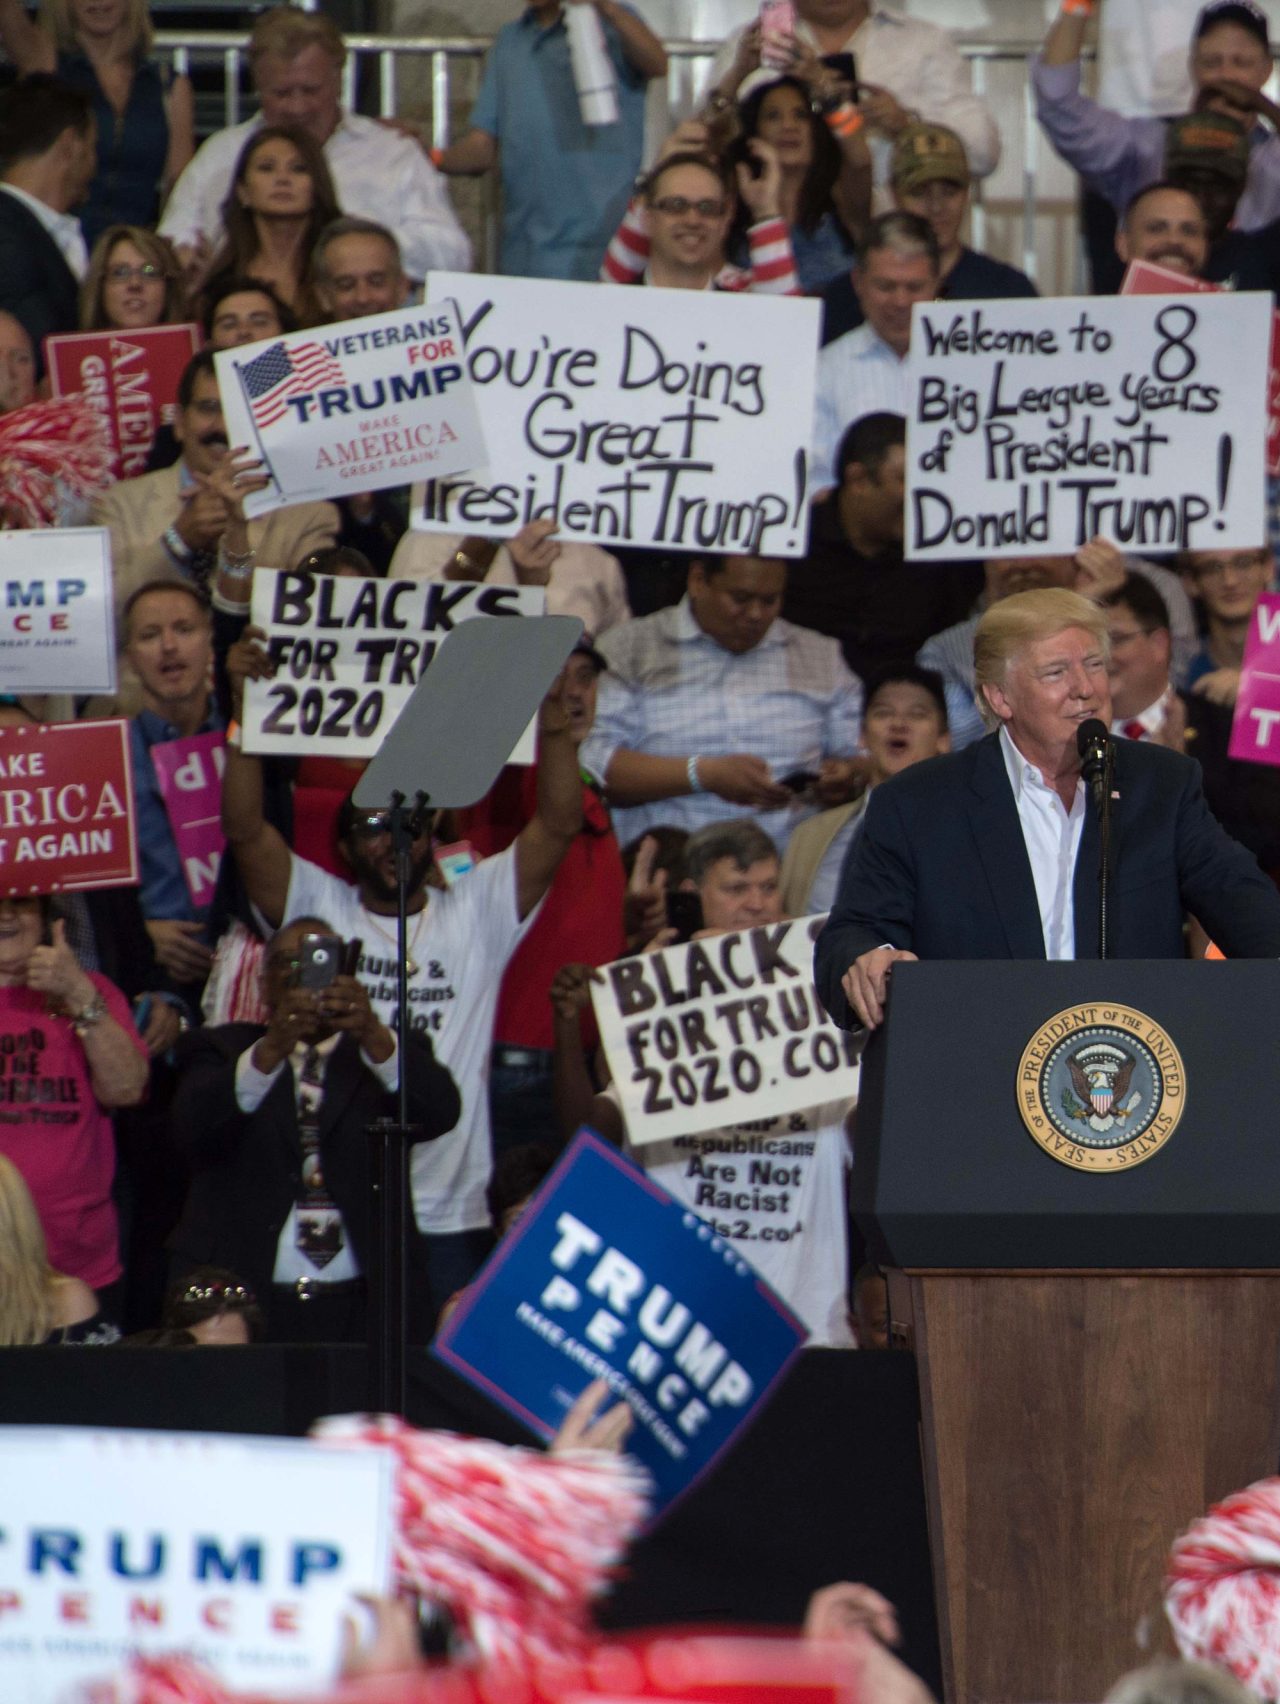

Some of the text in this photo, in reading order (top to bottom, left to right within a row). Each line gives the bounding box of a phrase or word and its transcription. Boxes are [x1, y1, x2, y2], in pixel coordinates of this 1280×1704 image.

[324, 315, 450, 358] VETERANS
[407, 337, 456, 365] FOR
[921, 304, 1198, 383] Welcome to 8
[286, 363, 463, 424] TRUMP
[620, 325, 764, 416] Doing
[918, 377, 978, 433] Big
[987, 361, 1110, 429] League
[314, 420, 459, 470] AMERICA
[525, 392, 719, 465] Great
[918, 416, 1168, 480] of President
[339, 460, 385, 479] GREAT
[637, 447, 807, 556] Trump!
[912, 433, 1233, 550] Donald Trump!
[268, 635, 340, 682] FOR
[0, 781, 127, 829] RICA
[15, 828, 113, 862] AGAIN
[608, 919, 825, 1017] BLACK
[625, 983, 830, 1070] FOR TRU
[1023, 1008, 1180, 1164] SEAL OF THE PRESIDENT OF THE UNITED STATES
[685, 1154, 803, 1187] Are Not
[694, 1181, 791, 1214] Racist
[515, 1301, 567, 1348] MAKE
[550, 1211, 755, 1408] TRUMP
[539, 1274, 712, 1437] PENCE
[0, 1523, 346, 1590] RUMP
